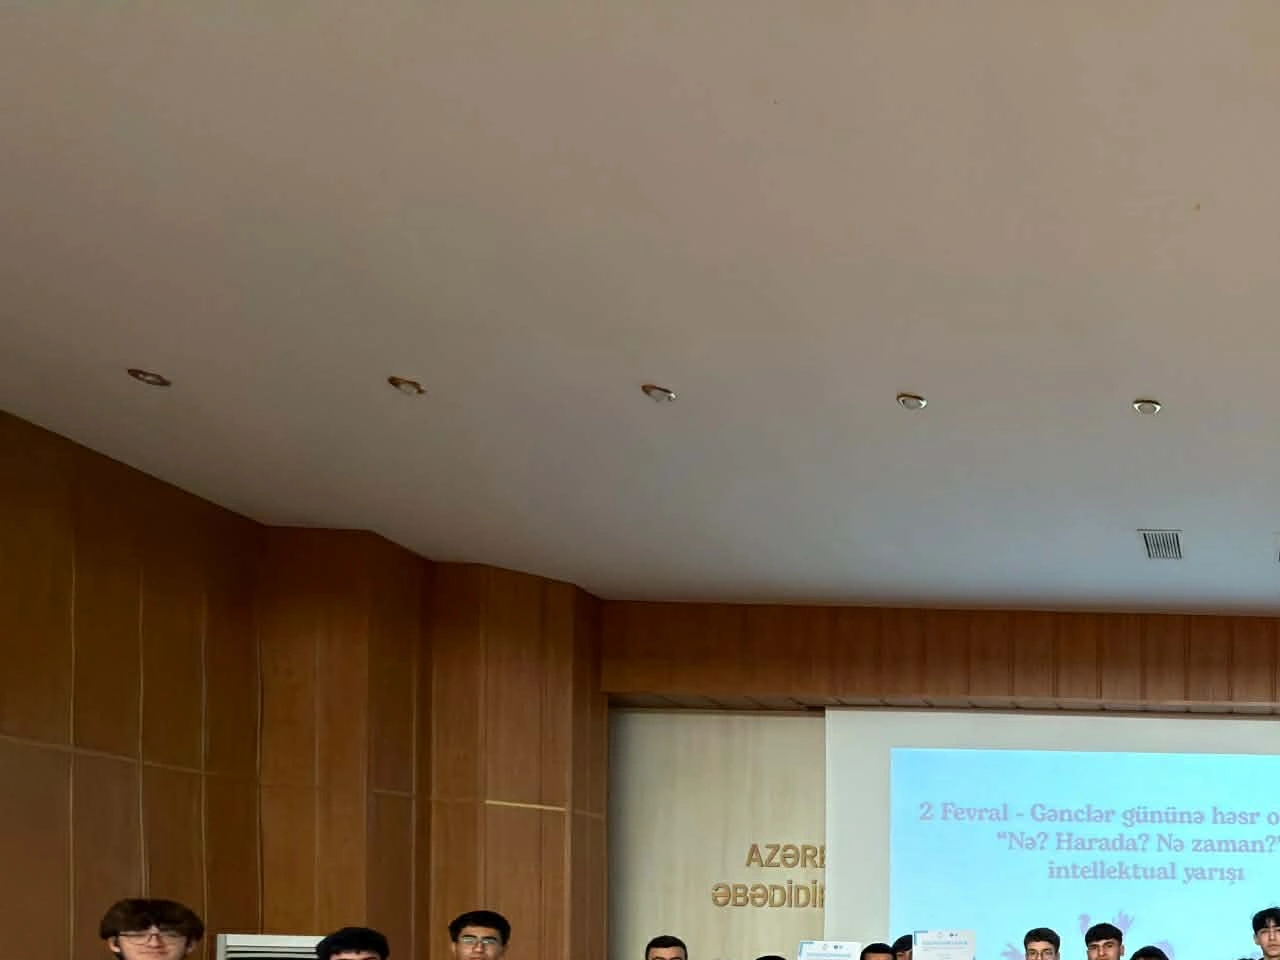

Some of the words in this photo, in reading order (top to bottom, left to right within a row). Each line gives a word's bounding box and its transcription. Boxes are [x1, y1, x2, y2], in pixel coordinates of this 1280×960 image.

[919, 801, 933, 821] 2
[940, 802, 1008, 822] Fevral
[1030, 803, 1115, 823] Gənclər
[1122, 806, 1204, 828] gününə
[1211, 806, 1260, 825] həsr
[1056, 832, 1150, 852] Harada?
[1156, 833, 1185, 852] Nə
[1048, 861, 1176, 880] intellektual
[1182, 866, 1245, 885] yarışı
